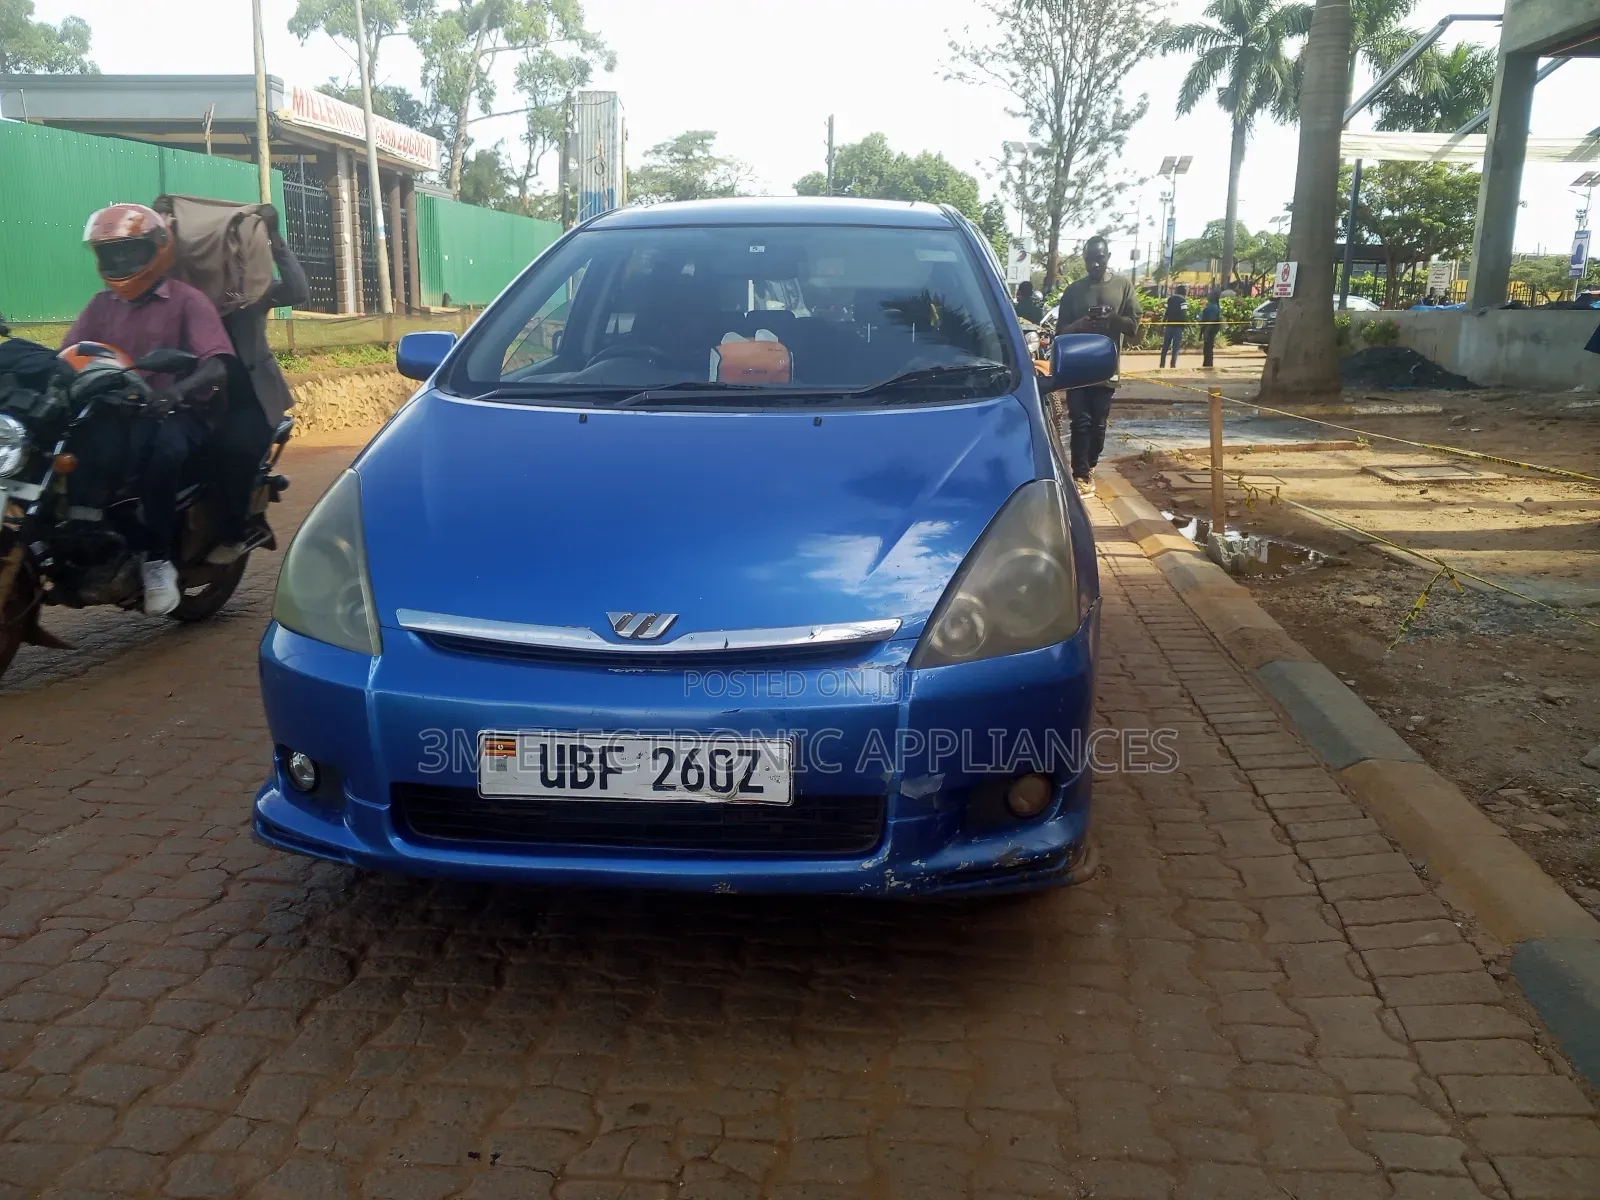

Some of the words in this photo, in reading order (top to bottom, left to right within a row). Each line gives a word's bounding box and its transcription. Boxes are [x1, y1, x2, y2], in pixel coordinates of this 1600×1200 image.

[293, 86, 367, 134] MILLENNIU
[397, 132, 433, 161] LUGOGO
[540, 743, 625, 790] UBF
[652, 747, 764, 794] 260Z
